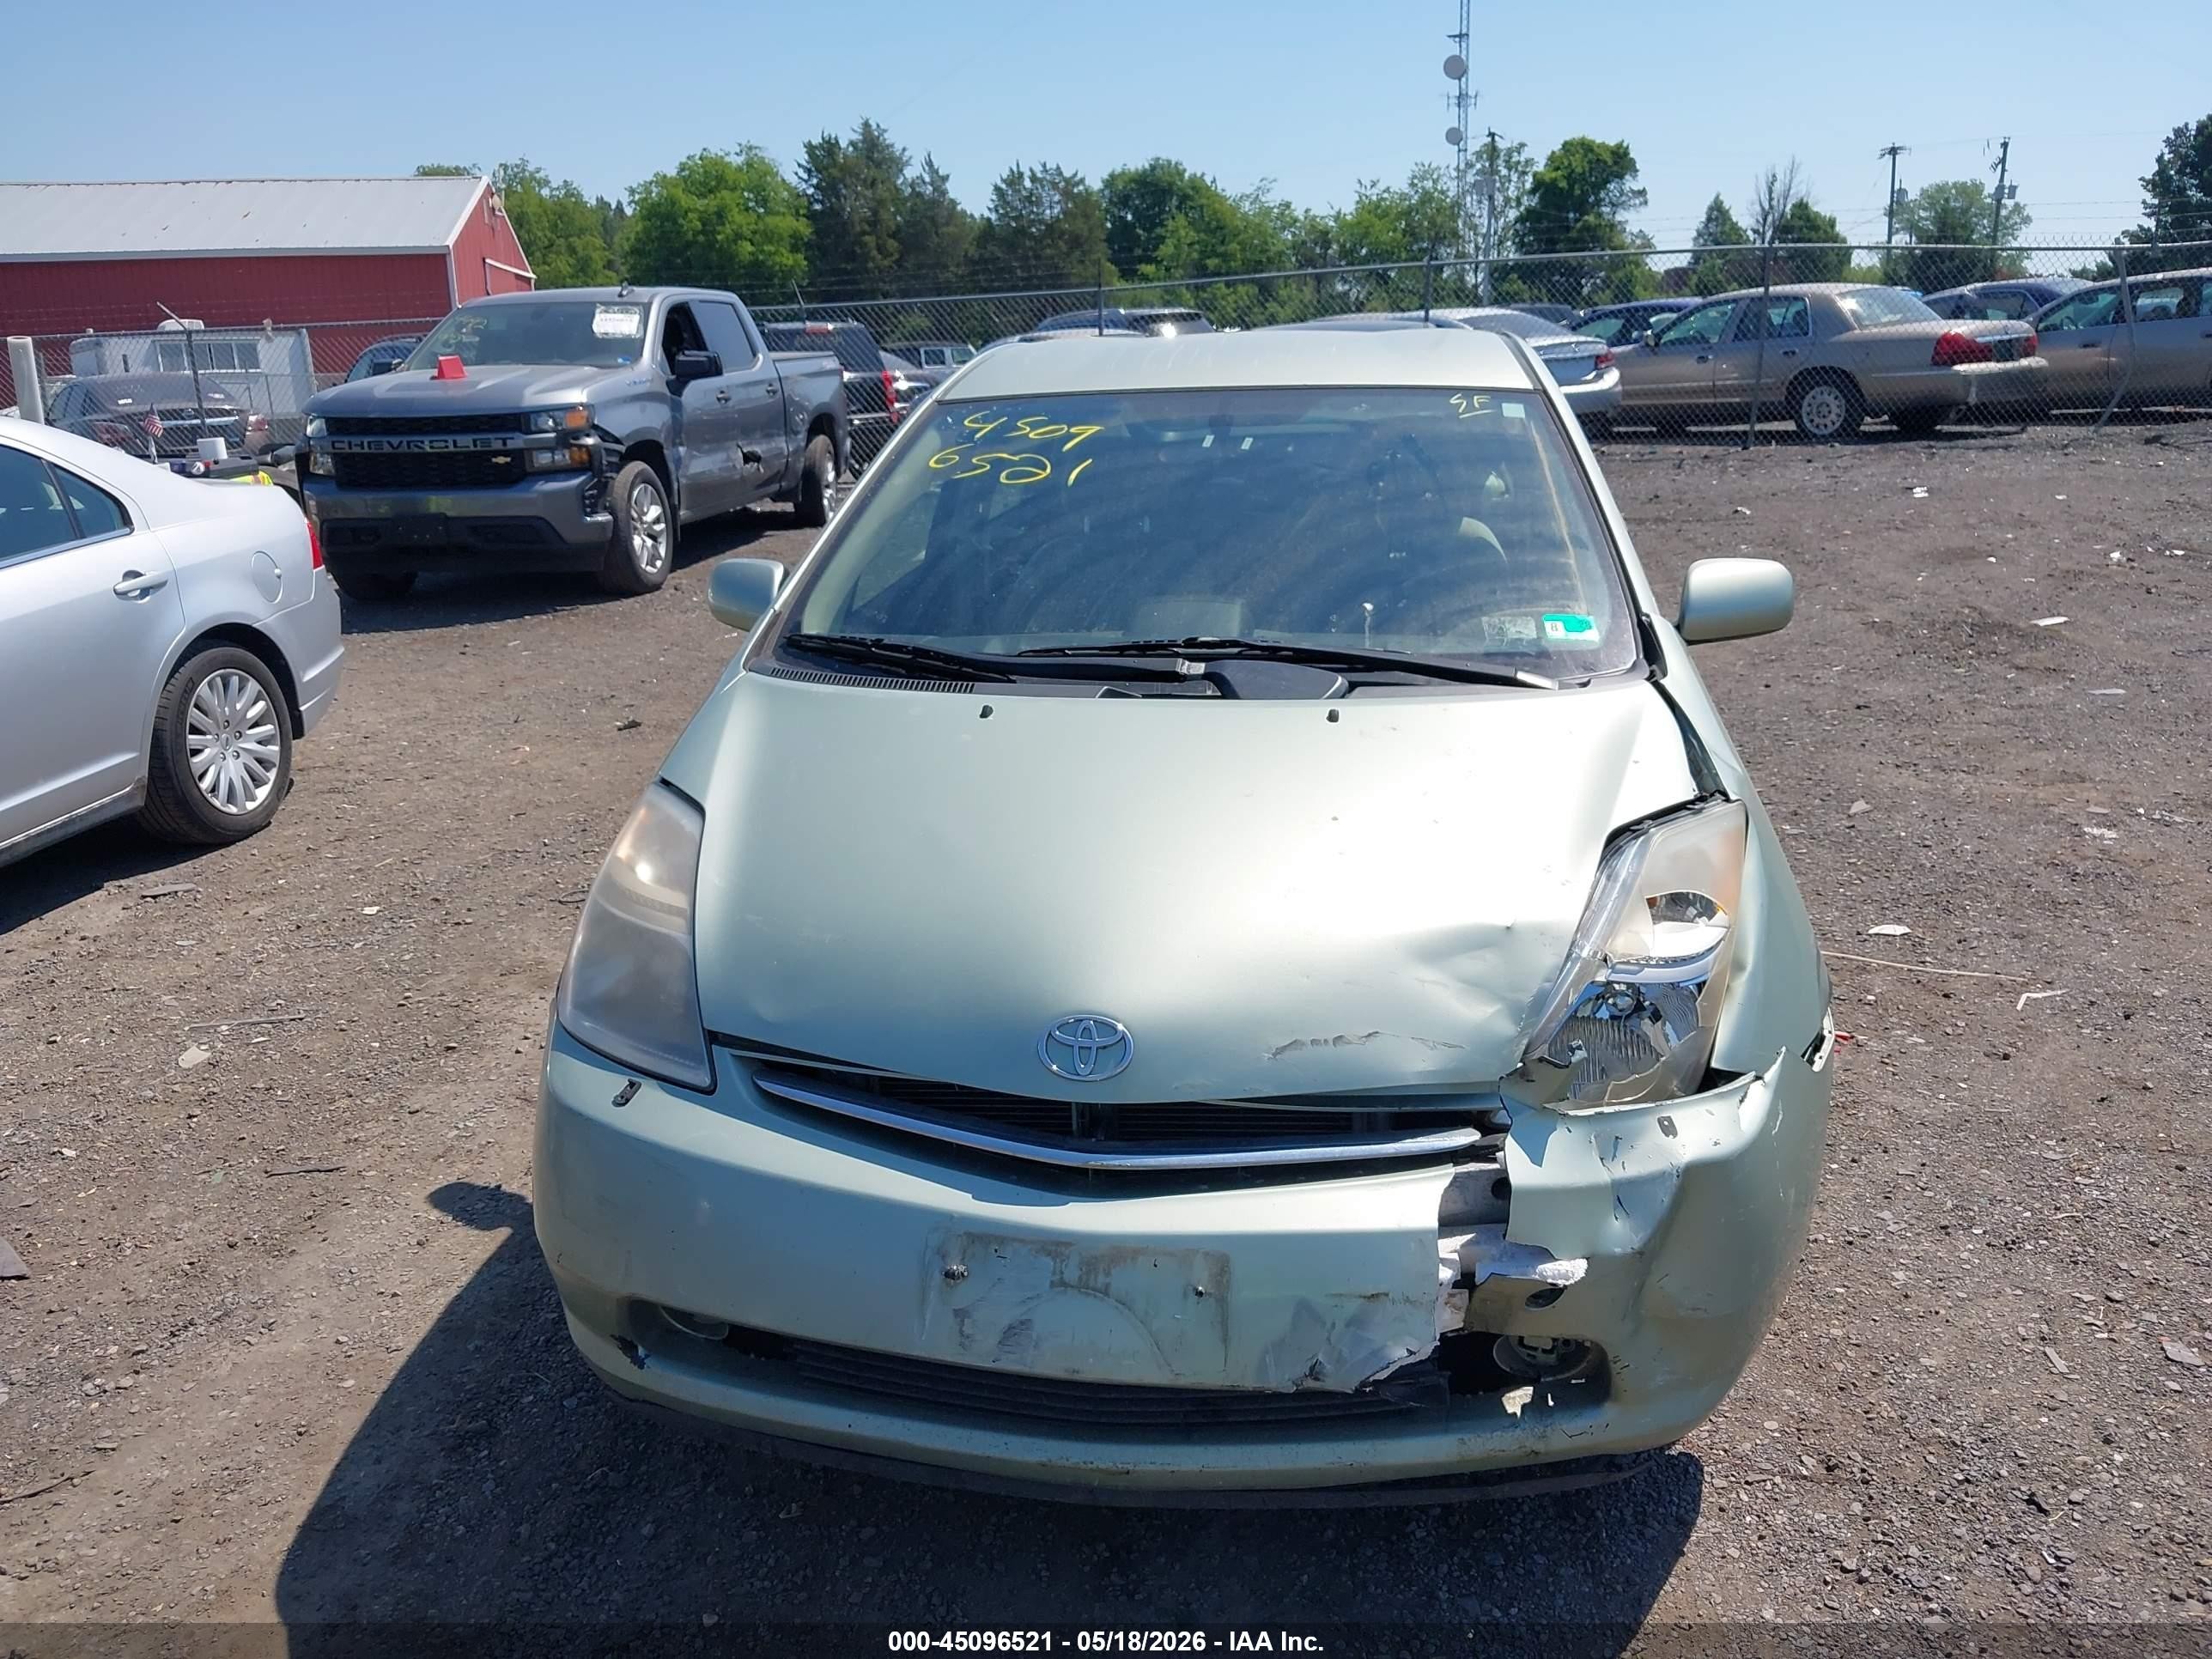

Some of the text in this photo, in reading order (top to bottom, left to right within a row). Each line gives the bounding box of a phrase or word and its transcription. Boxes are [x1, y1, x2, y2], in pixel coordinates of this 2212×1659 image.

[331, 436, 515, 451] CHEVROLET
[963, 410, 1104, 452] 4509
[928, 443, 1093, 486] 6521
